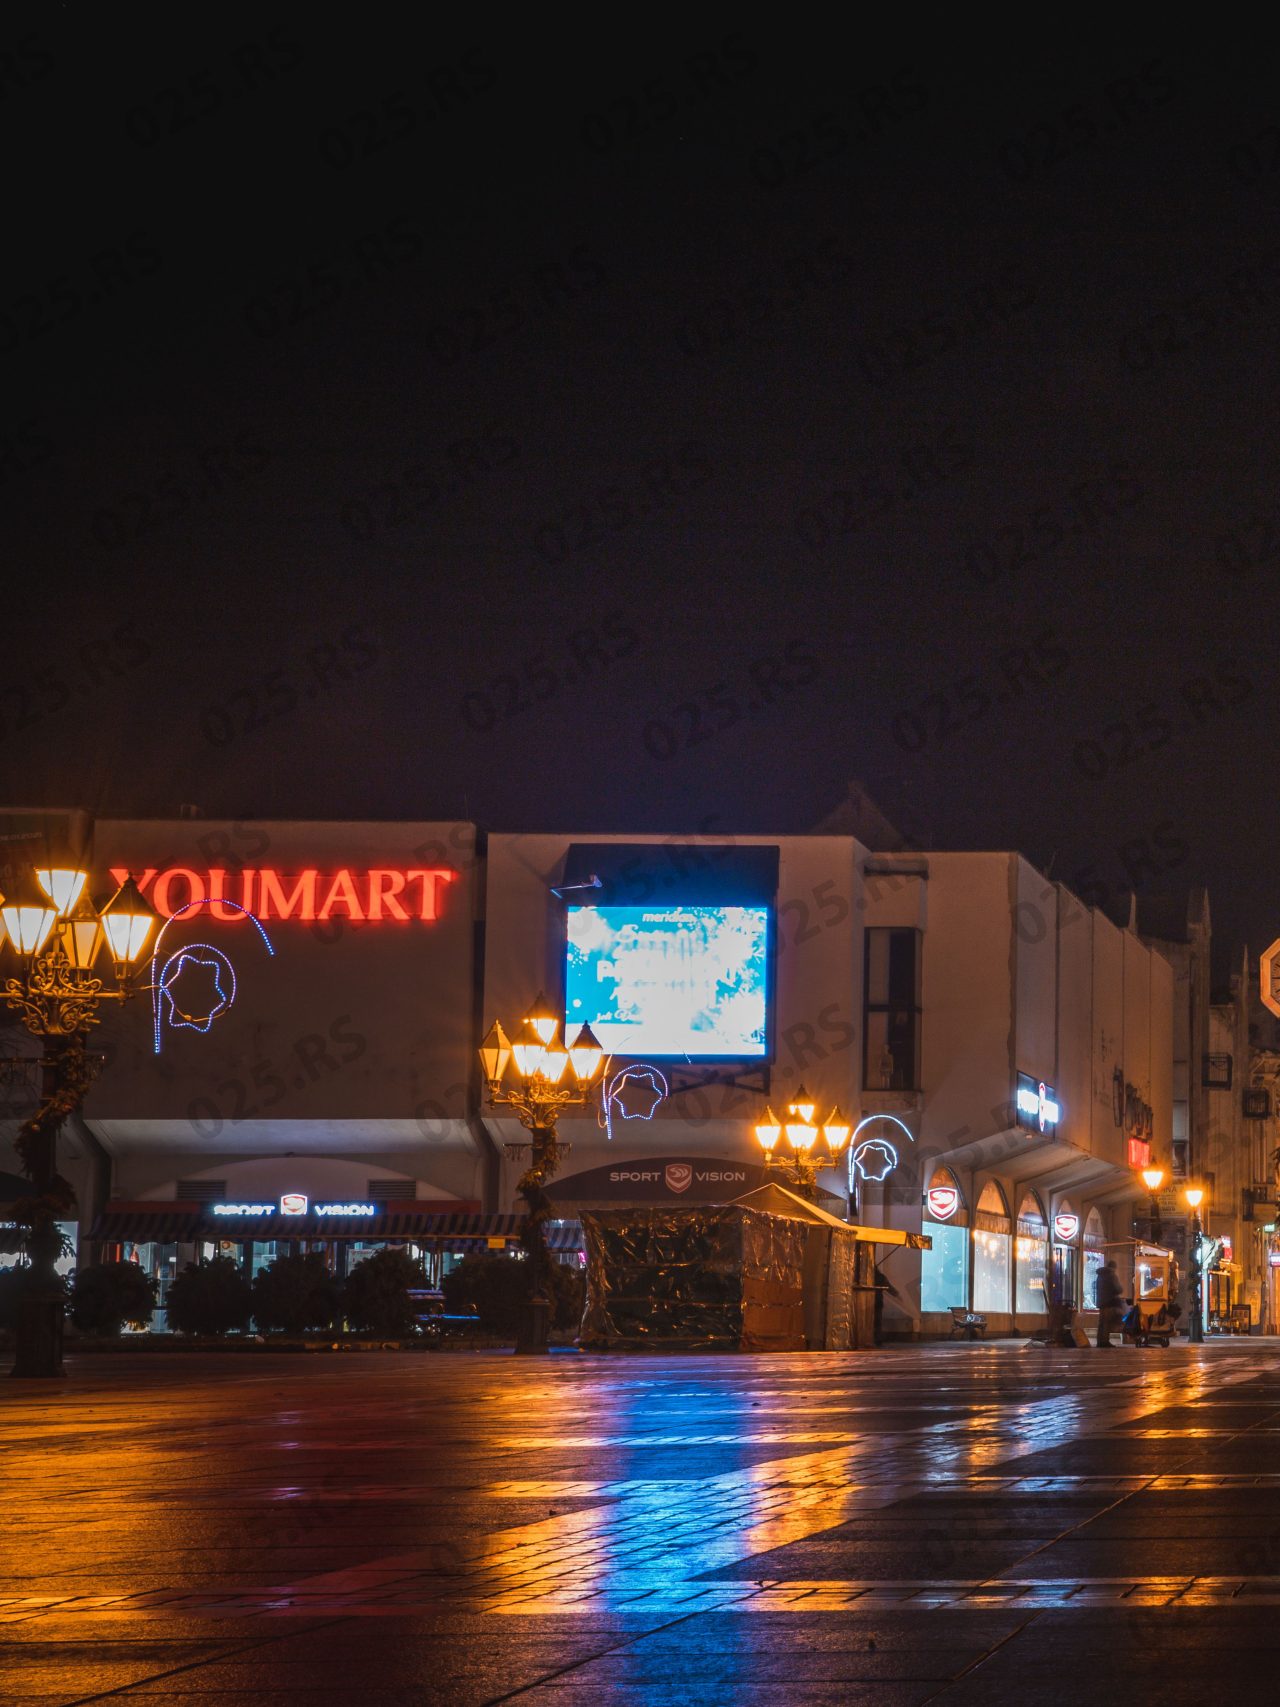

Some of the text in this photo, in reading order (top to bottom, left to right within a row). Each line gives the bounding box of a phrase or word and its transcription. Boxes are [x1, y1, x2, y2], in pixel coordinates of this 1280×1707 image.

[609, 1172, 745, 1182] SPORT VISION
[213, 1205, 374, 1216] SPORT VISION
